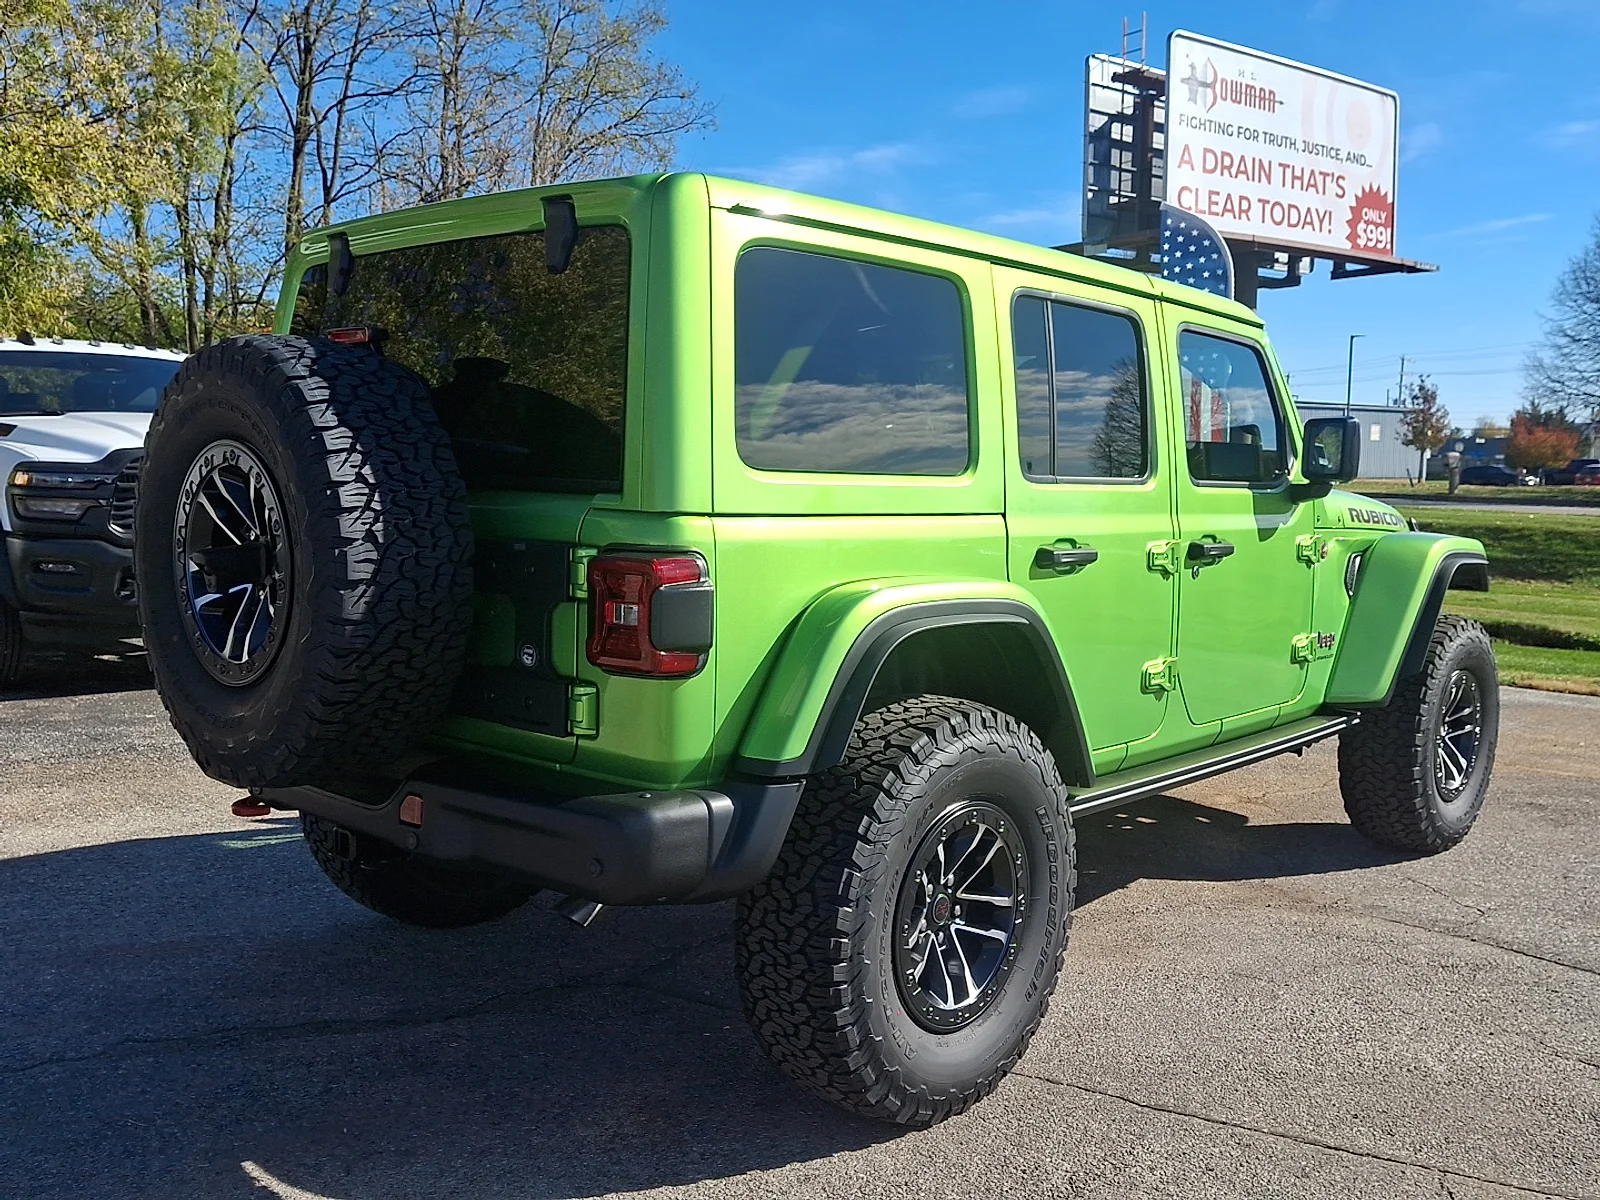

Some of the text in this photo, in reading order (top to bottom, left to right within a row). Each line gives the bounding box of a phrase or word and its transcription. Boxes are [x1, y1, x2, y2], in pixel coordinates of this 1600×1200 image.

[1179, 113, 1234, 137] FIGHTING
[1237, 126, 1260, 143] FOR
[1262, 131, 1299, 153] TRUTH,
[1302, 140, 1344, 164] JUSTICE,
[1177, 144, 1346, 199] A DRAIN THAT'S
[1177, 186, 1333, 235] CLEAR TODAY!
[1362, 207, 1387, 224] ONLY
[1356, 219, 1391, 249] $99!
[1348, 507, 1406, 528] RUBICON
